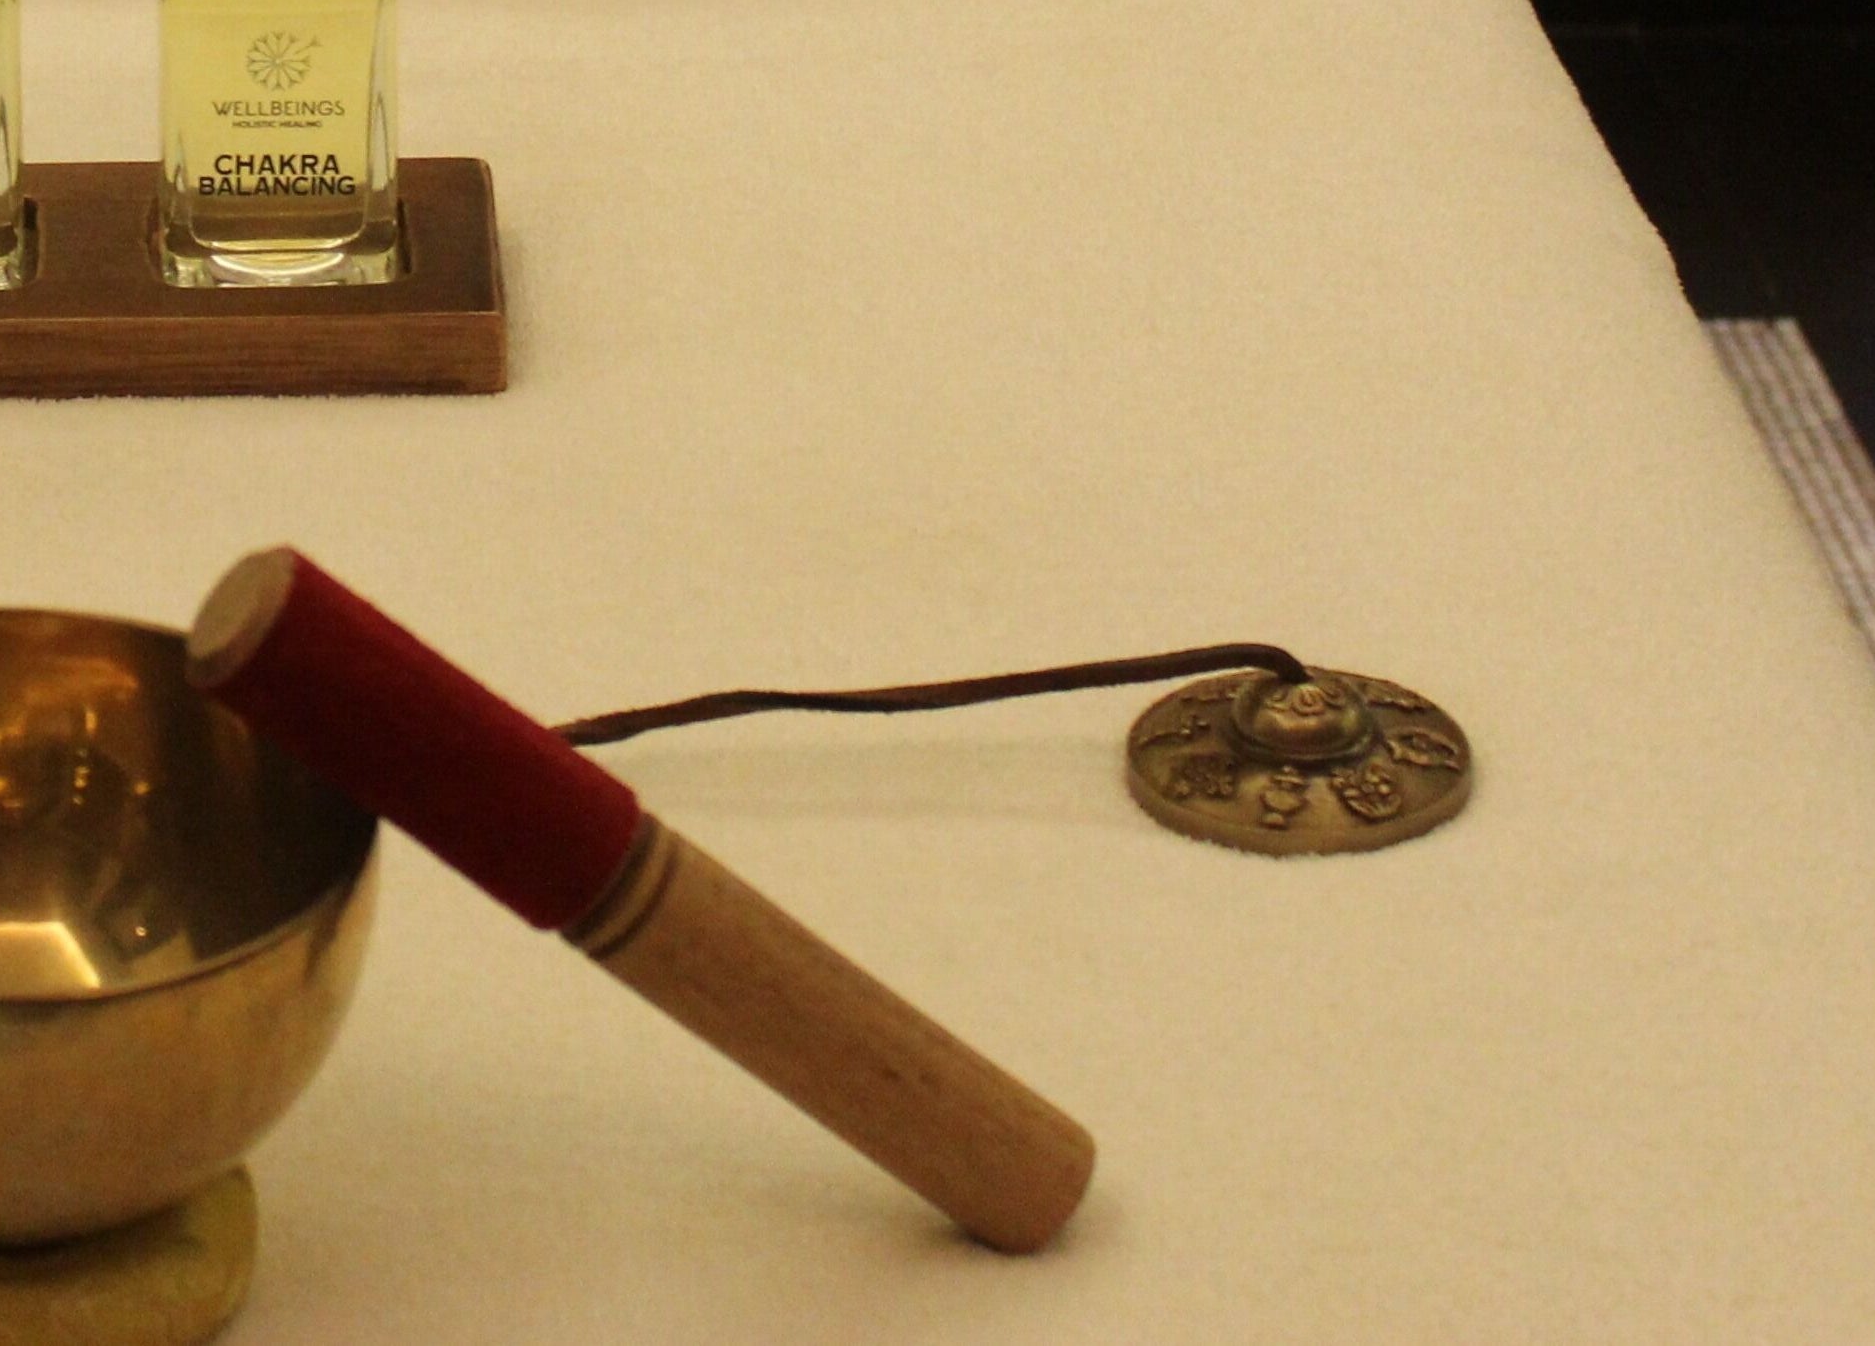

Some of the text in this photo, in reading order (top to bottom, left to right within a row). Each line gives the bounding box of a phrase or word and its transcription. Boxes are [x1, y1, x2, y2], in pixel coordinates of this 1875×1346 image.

[212, 101, 345, 116] WELLBEINGS
[214, 155, 340, 175] CHAKRA
[199, 176, 355, 196] BALANCING
